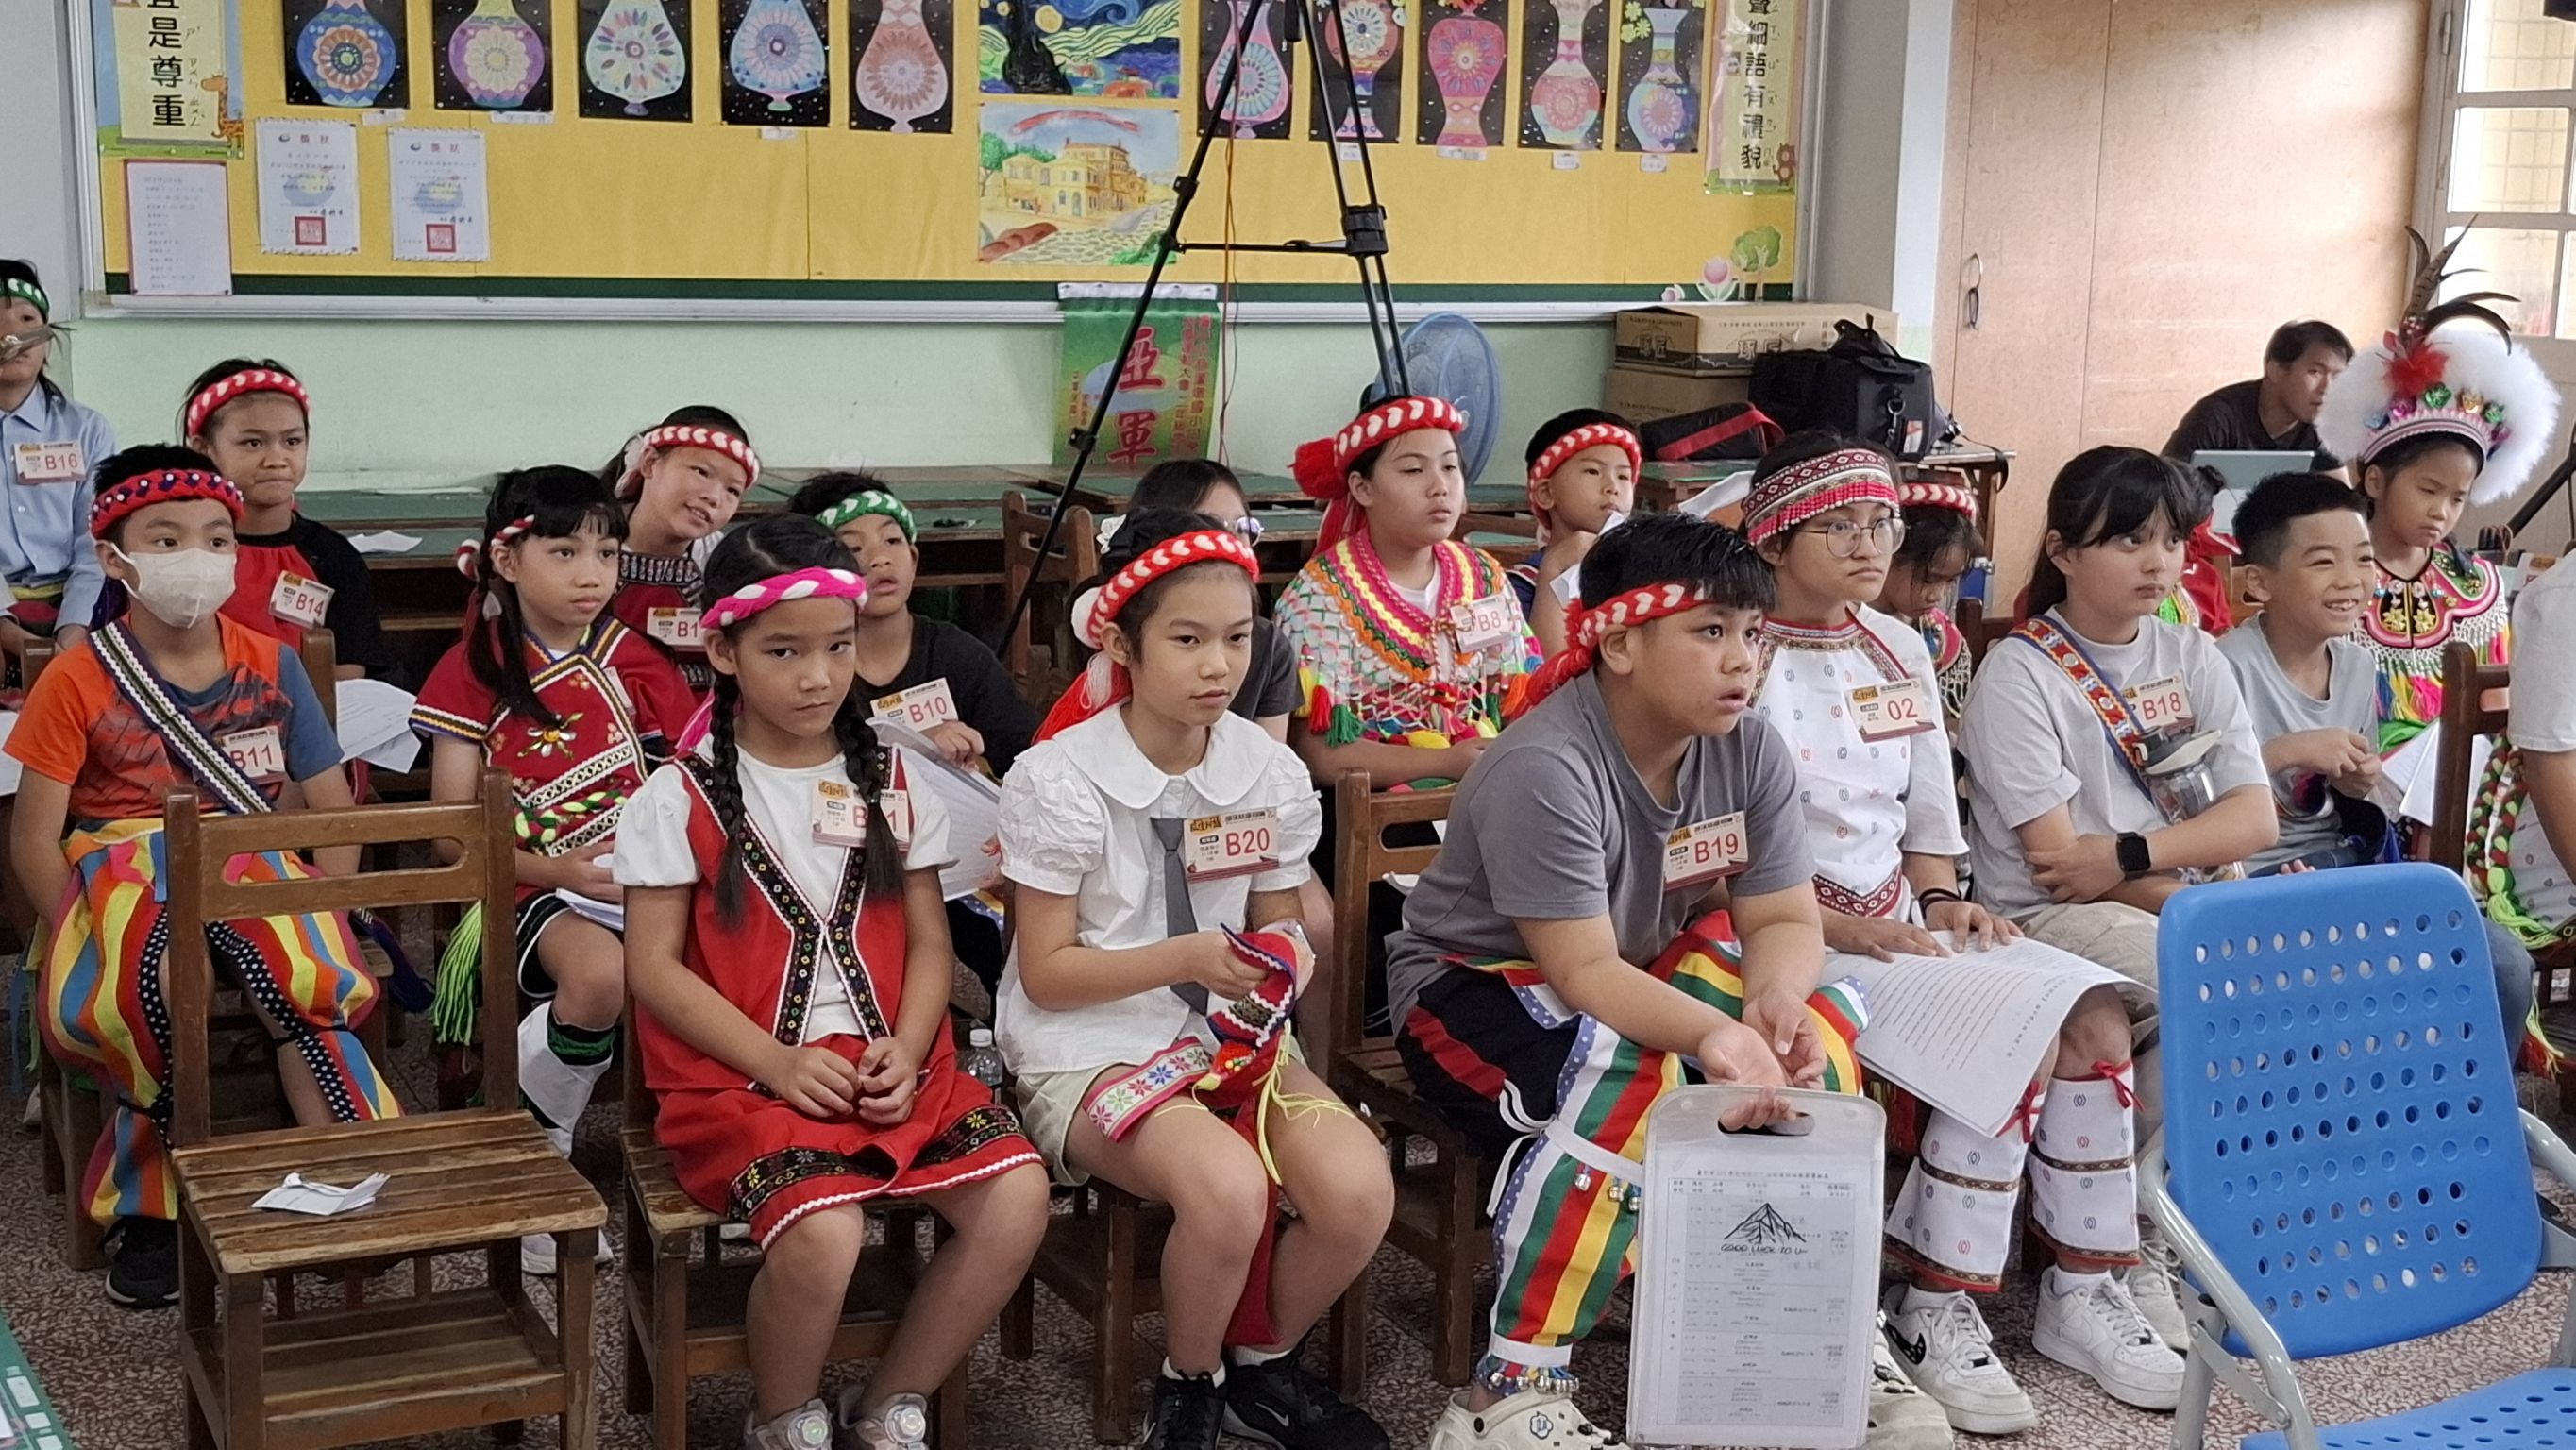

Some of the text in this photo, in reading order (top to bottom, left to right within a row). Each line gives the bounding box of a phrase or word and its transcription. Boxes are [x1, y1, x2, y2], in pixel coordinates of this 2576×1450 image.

[45, 453, 77, 470] B16
[295, 593, 324, 617] B14
[1478, 611, 1501, 632] B8
[909, 697, 947, 723] B10
[1888, 698, 1918, 720] 02
[2142, 692, 2181, 720] B18
[230, 744, 272, 769] B11
[853, 805, 897, 832] B1
[1226, 828, 1270, 856] B20
[1695, 833, 1738, 863] B19
